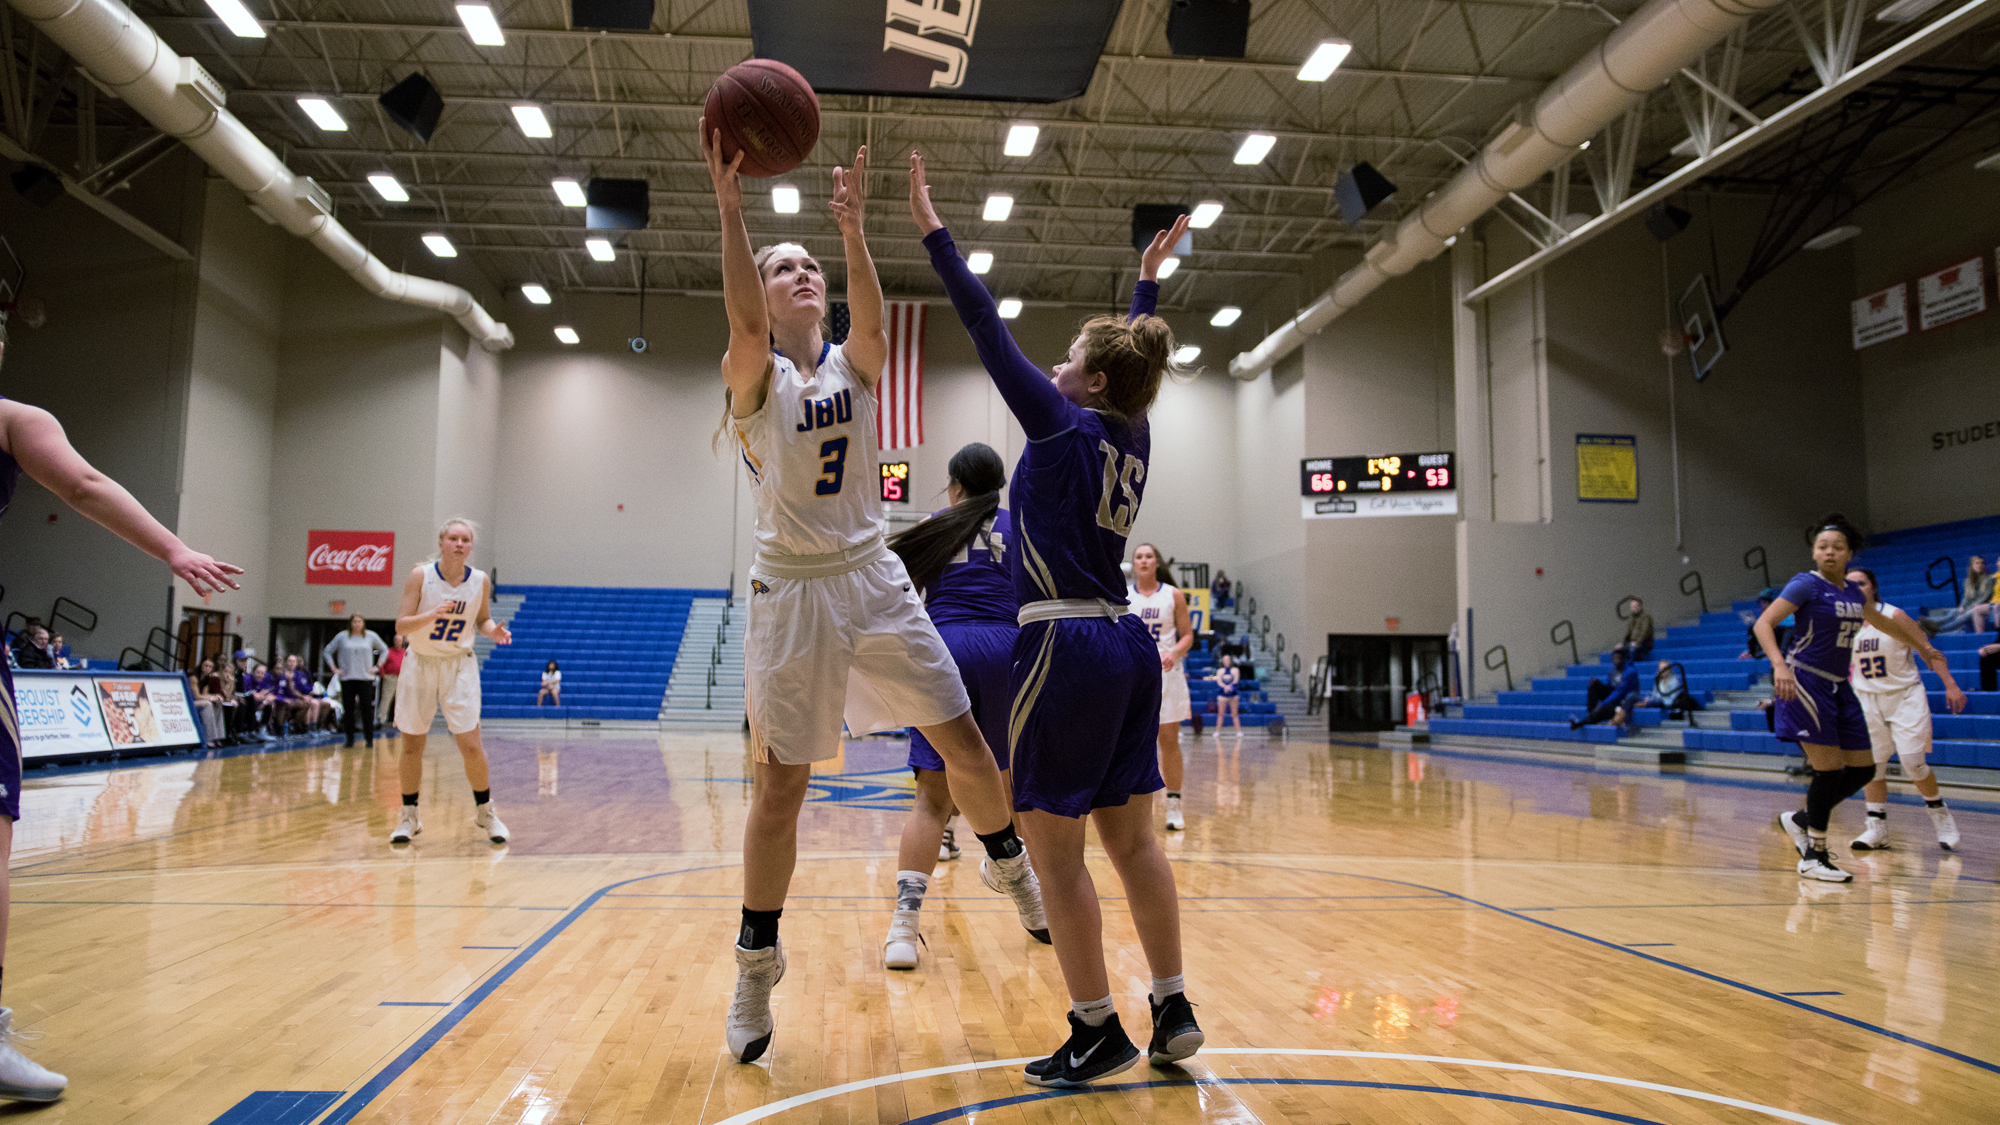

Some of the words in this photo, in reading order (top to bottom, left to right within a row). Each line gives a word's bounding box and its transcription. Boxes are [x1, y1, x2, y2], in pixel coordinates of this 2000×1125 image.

[796, 388, 852, 432] JBU
[814, 434, 849, 498] 3
[1306, 460, 1333, 471] HOME
[1367, 456, 1401, 476] 1:42
[1418, 454, 1450, 466] GUEST
[1310, 473, 1334, 492] 66
[1425, 468, 1449, 487] 53
[883, 476, 902, 500] 15
[1096, 439, 1145, 538] 15
[1835, 601, 1864, 619] SAG
[429, 618, 466, 641] 32
[1855, 638, 1879, 653] JBU
[1860, 655, 1887, 679] 23
